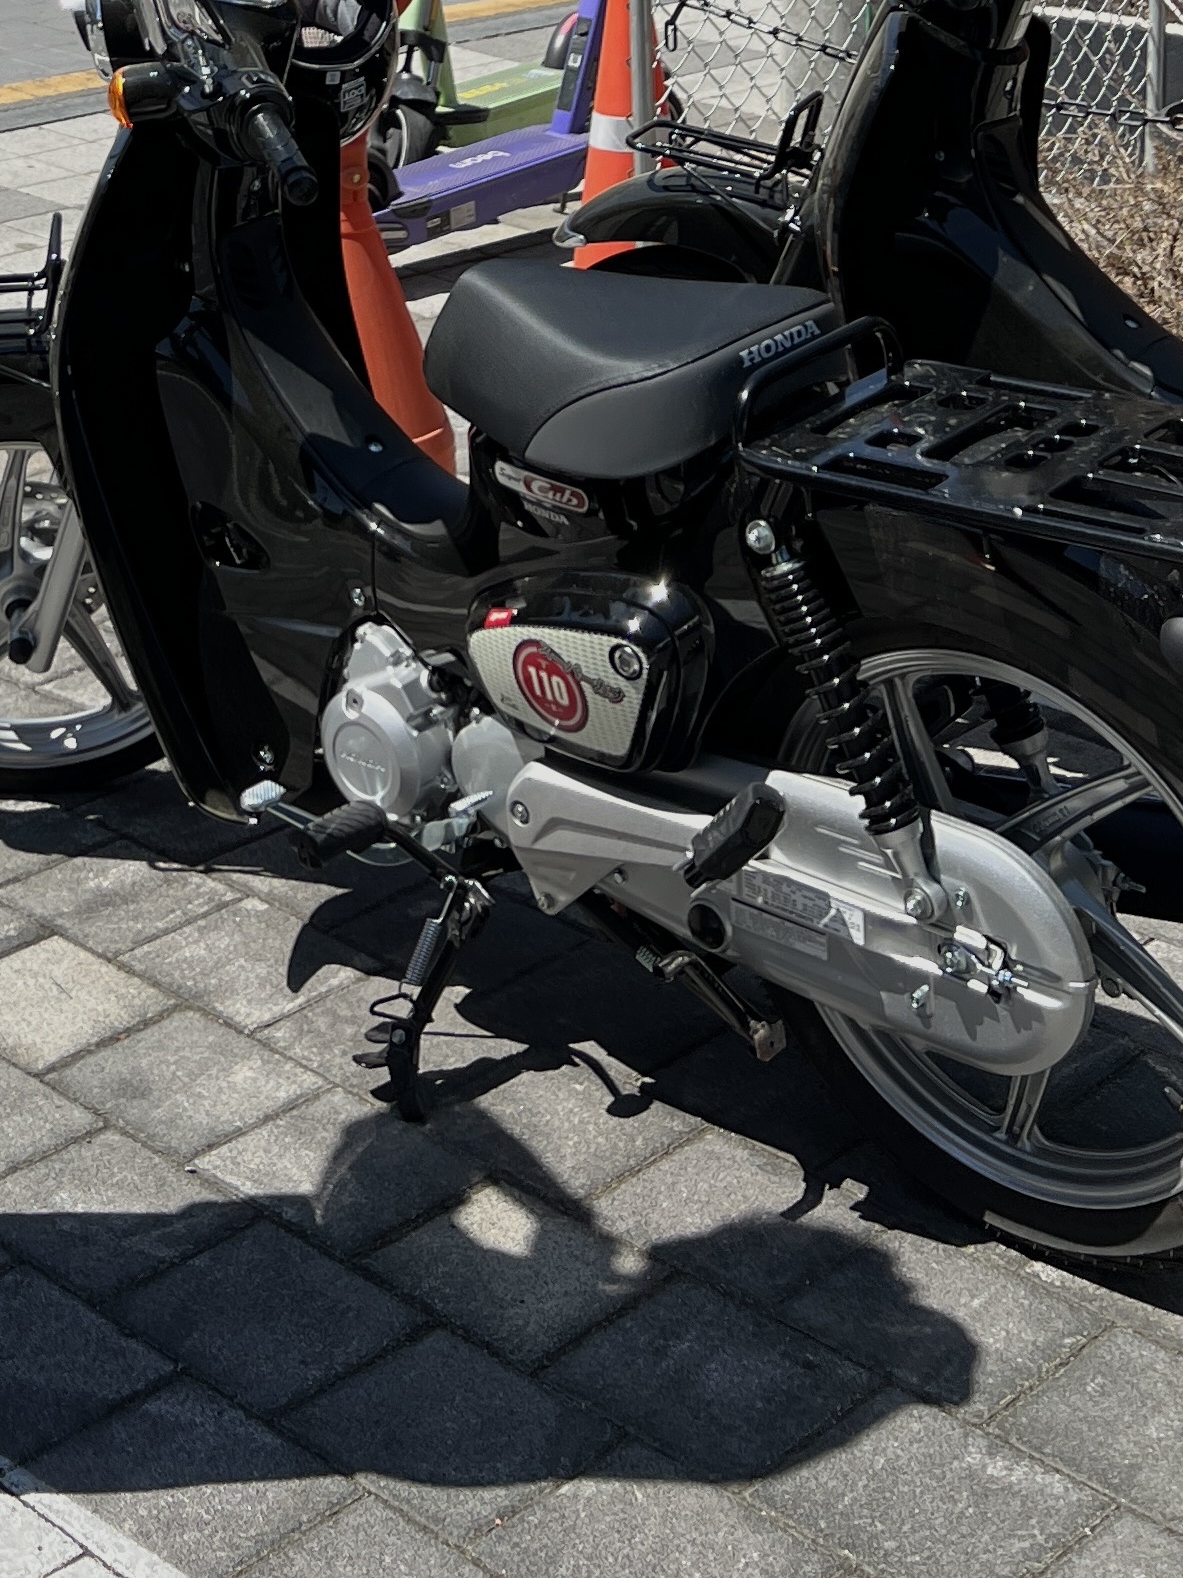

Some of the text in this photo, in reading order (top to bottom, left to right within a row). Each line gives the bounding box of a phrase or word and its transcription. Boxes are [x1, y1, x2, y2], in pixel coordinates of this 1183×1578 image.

[738, 319, 822, 368] HONDA
[530, 478, 579, 507] Cub
[524, 501, 570, 526] HONDA
[527, 664, 571, 708] 110
